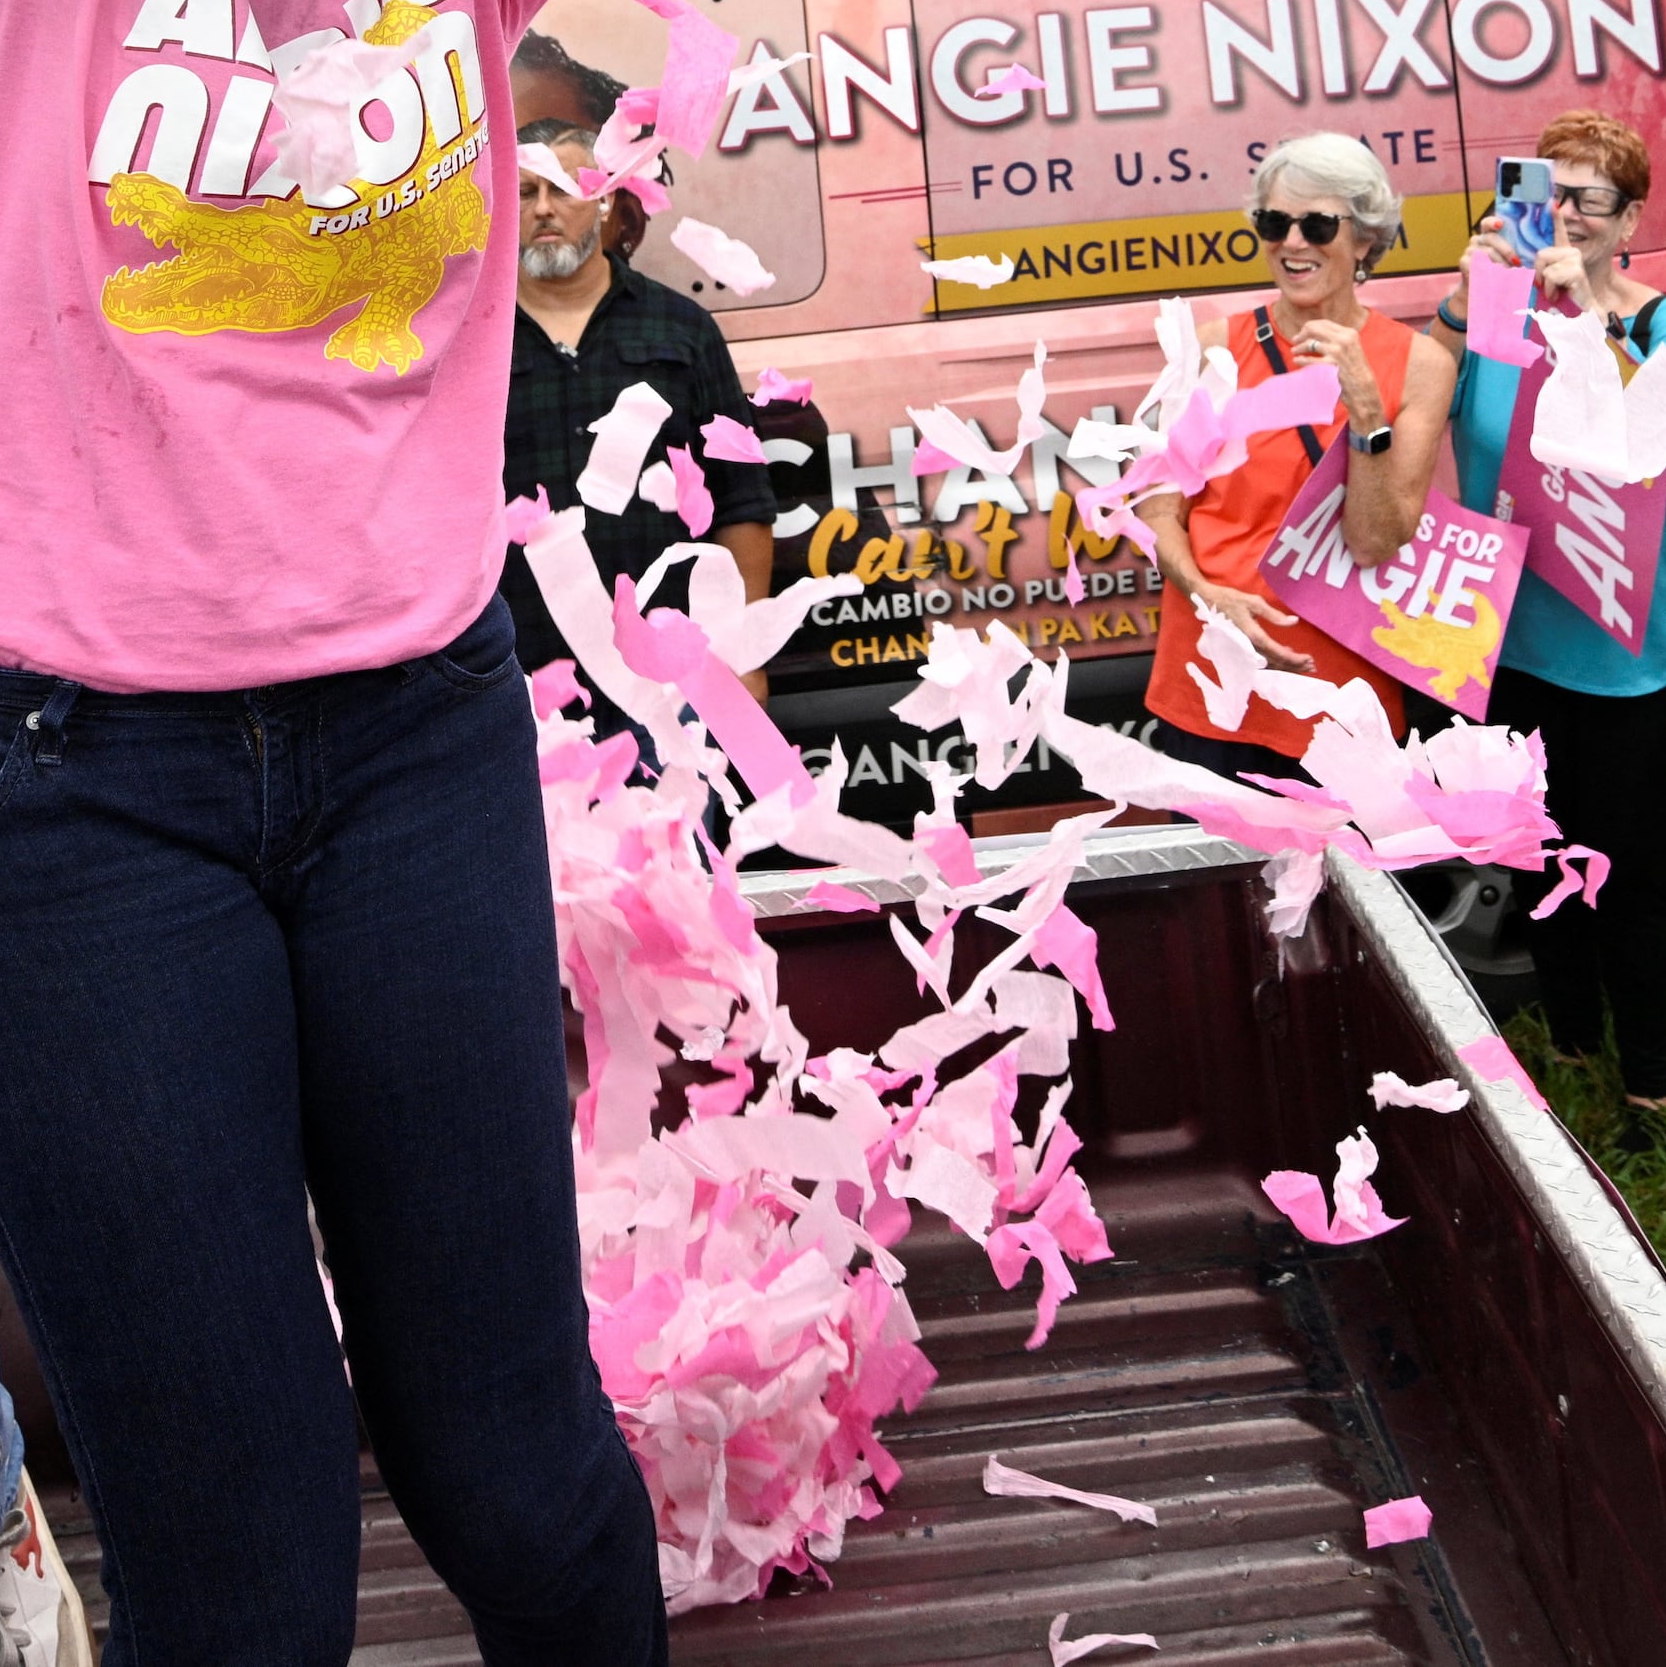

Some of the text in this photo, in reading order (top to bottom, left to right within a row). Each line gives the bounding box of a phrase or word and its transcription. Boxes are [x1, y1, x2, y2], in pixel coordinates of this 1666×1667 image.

[717, 5, 1163, 150] ANGIE
[971, 129, 1437, 200] FOR U.S. STE
[309, 206, 371, 237] FOR
[376, 179, 424, 220] U.S.
[762, 405, 1170, 539] CHAN
[808, 500, 1018, 585] Can't
[1267, 483, 1495, 629] ANGIE
[1438, 523, 1503, 563] FOR
[811, 588, 952, 628] CAMBIO
[962, 584, 1015, 612] NO
[1025, 569, 1135, 605] PUEDE
[1040, 616, 1083, 646] PA
[1090, 610, 1138, 641] KA
